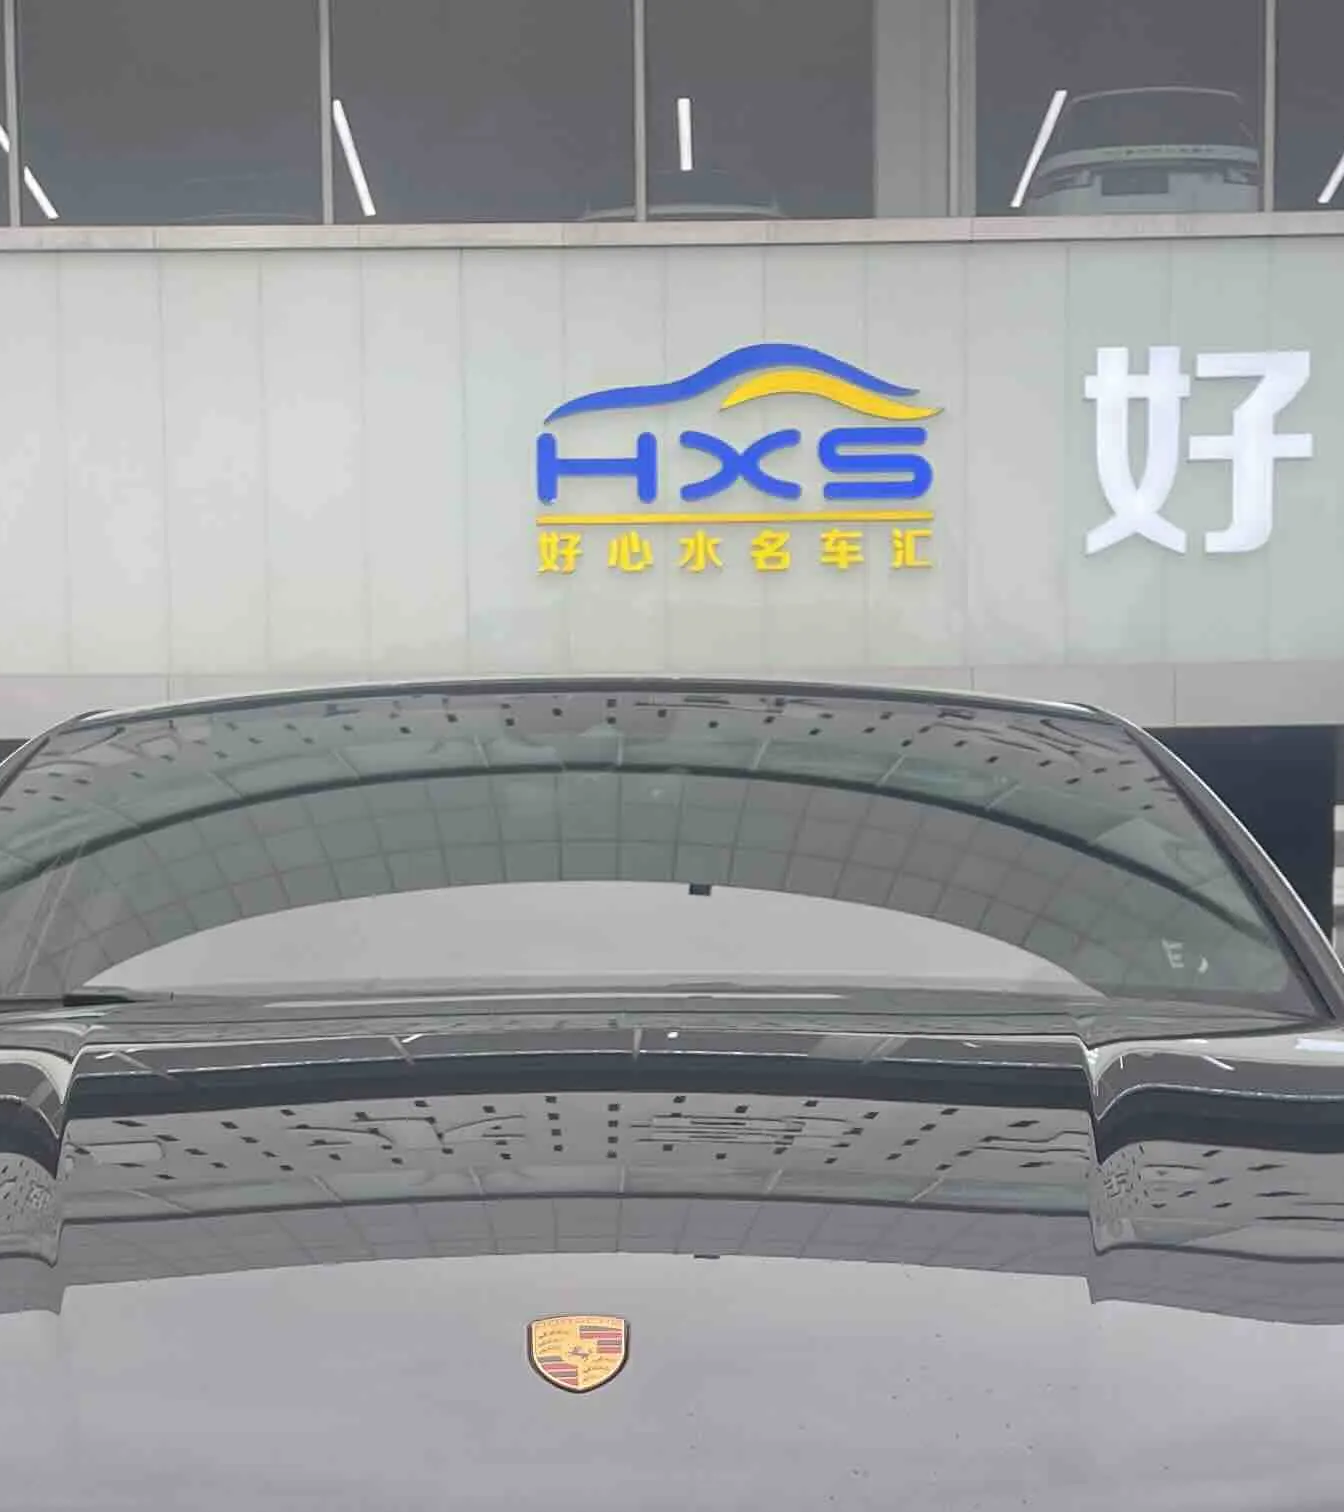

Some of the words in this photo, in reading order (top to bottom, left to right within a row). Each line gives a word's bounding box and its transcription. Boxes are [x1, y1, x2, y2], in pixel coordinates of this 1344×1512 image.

[537, 427, 934, 505] HXS
[537, 527, 934, 574] 好心水名车汇
